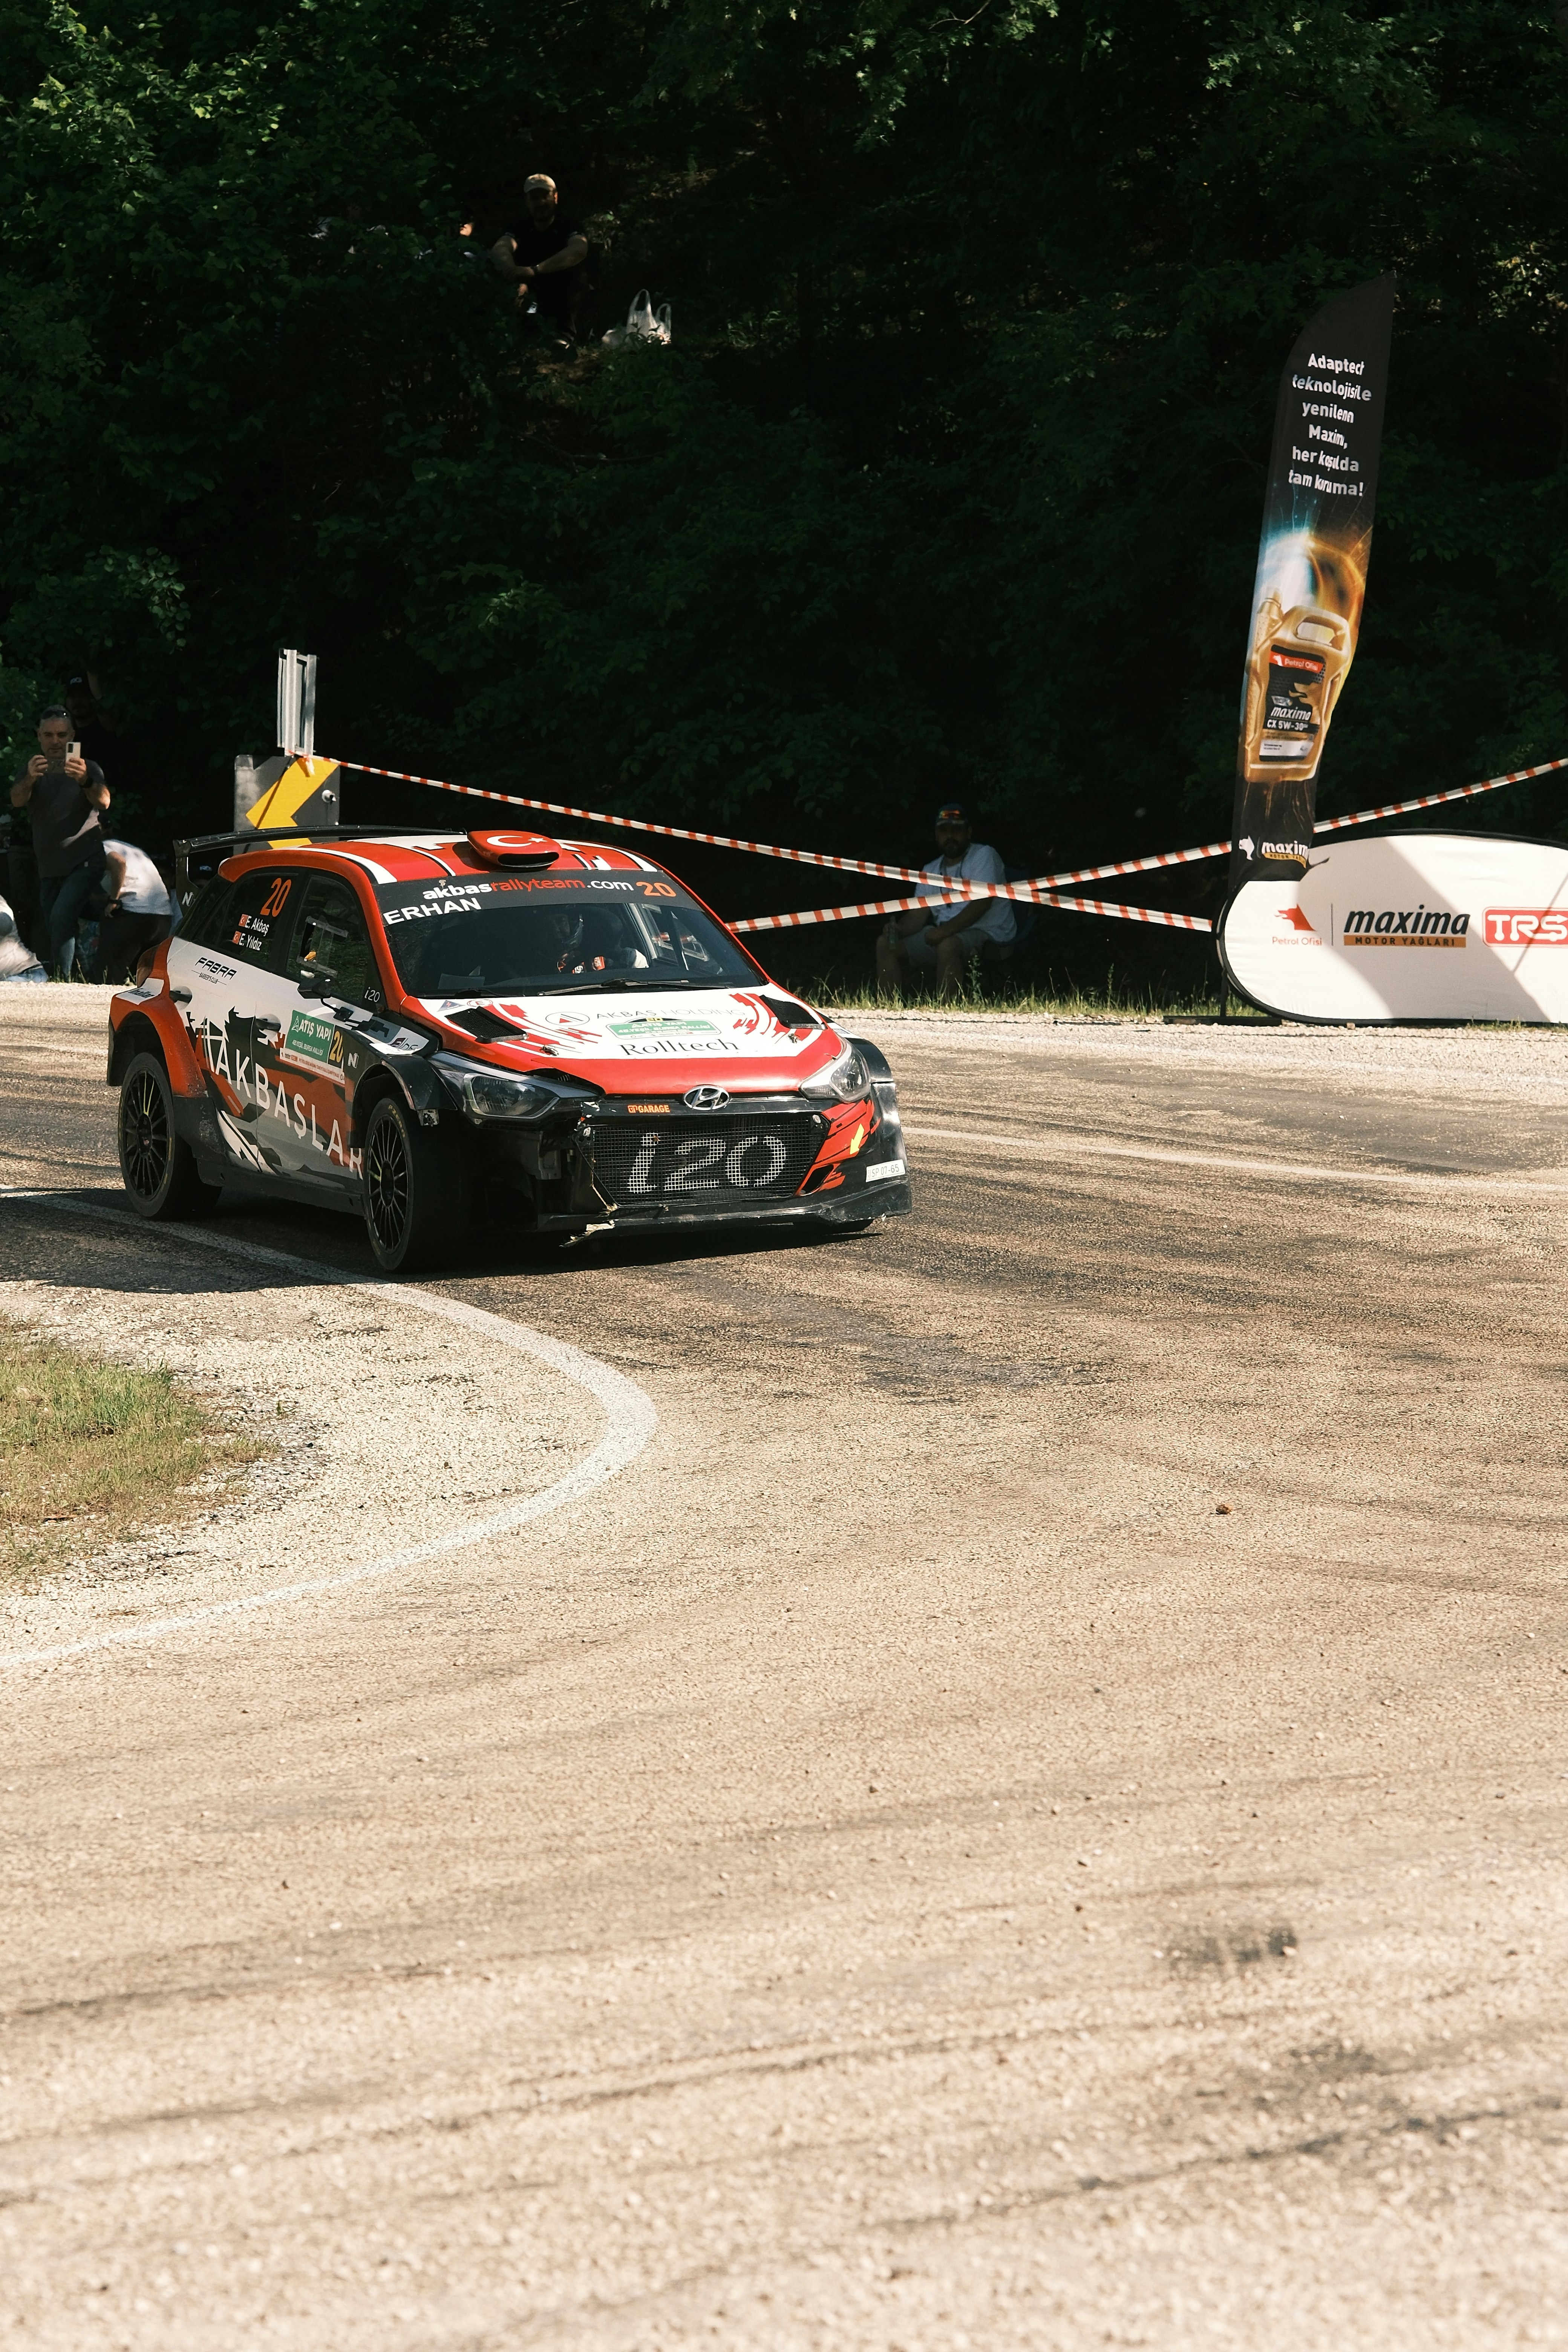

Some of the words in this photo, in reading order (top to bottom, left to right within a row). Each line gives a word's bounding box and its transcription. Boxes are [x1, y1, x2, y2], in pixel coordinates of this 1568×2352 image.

[1292, 446, 1318, 462] her
[1288, 469, 1312, 487] tam
[1267, 719, 1277, 729] CX
[260, 878, 291, 917] 20
[635, 881, 677, 897] 20
[383, 897, 482, 925] ERHAN
[1344, 904, 1471, 935] maxima
[251, 918, 270, 937] Akbaş
[239, 933, 245, 946] E.
[1272, 937, 1299, 945] Petrol
[1301, 937, 1322, 946] Ofisi
[194, 957, 237, 980] FABRA
[364, 987, 380, 1003] i20
[299, 1019, 314, 1037] ATIŞ
[316, 1024, 331, 1041] YAPI
[617, 1039, 741, 1056] Rolltech
[626, 1132, 786, 1194] i20
[881, 1164, 899, 1175] 07-65
